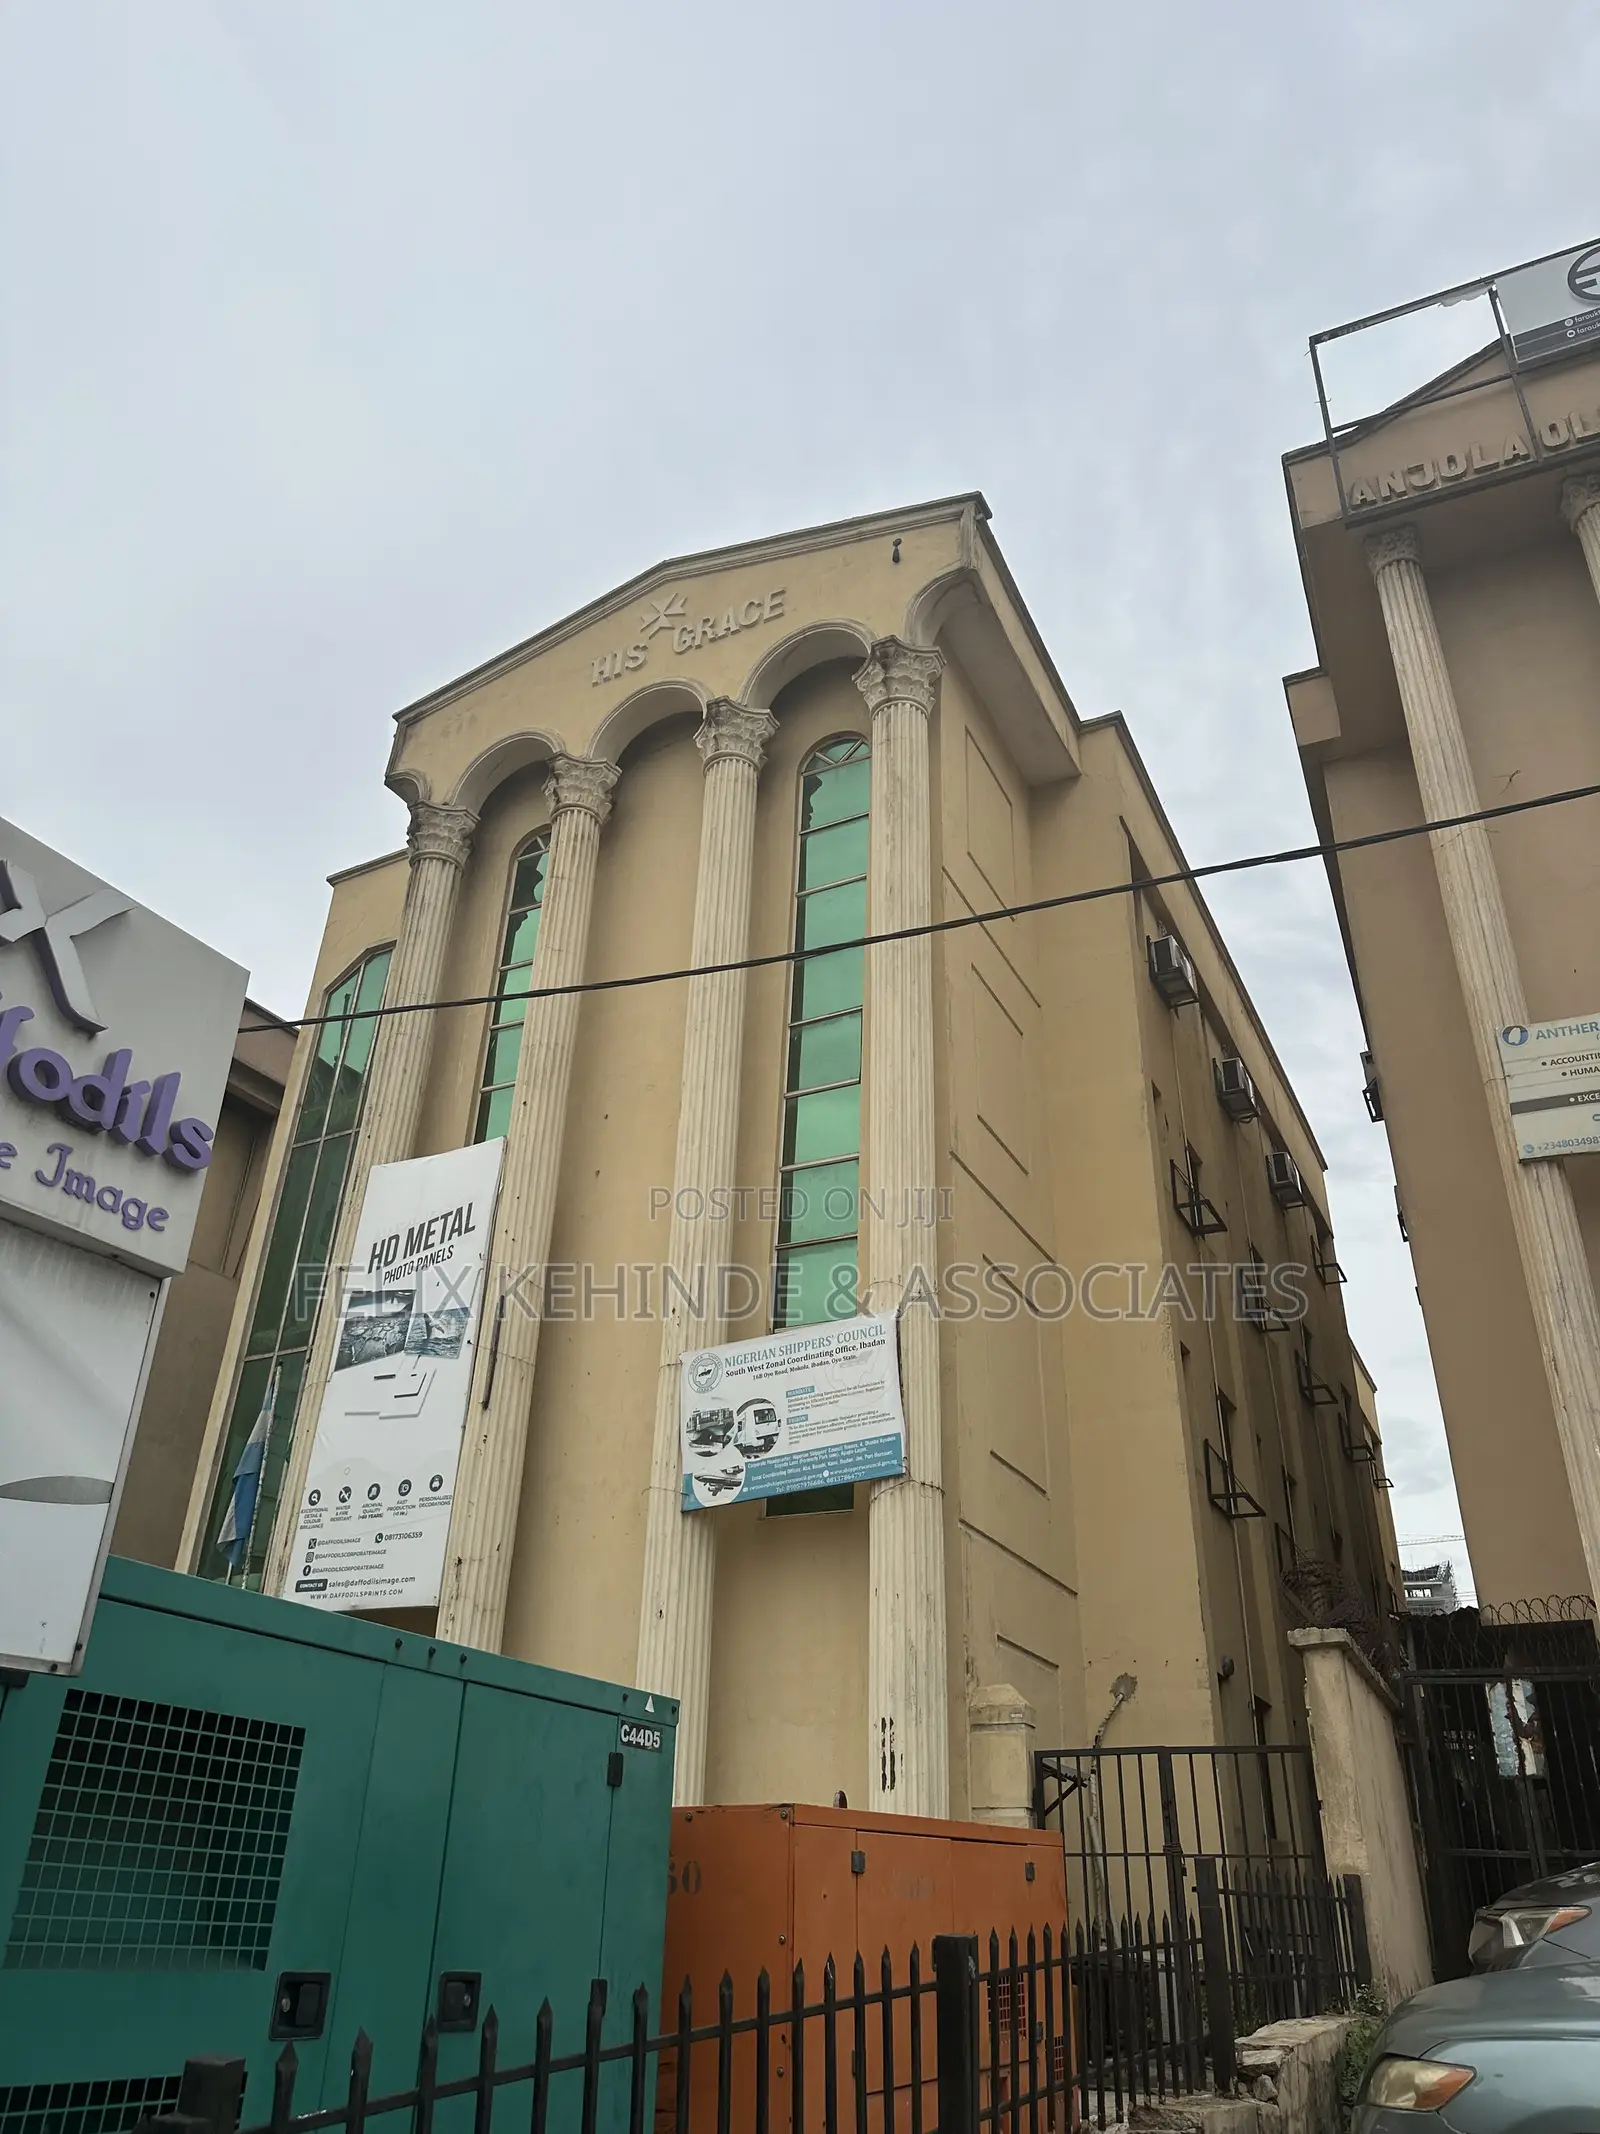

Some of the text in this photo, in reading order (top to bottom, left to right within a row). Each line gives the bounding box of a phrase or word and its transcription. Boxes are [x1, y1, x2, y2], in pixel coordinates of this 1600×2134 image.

[1351, 431, 1530, 507] ANJOLA
[591, 587, 787, 687] HIS GRACE
[367, 1201, 476, 1275] HD METAL
[383, 1244, 455, 1286] PHOTO PANELS
[724, 1347, 776, 1368] NIGERIAN
[837, 1325, 885, 1343] COUNCIL
[725, 1338, 886, 1377] South West Zonal Coordinating Office, Ibadan
[620, 1724, 661, 1749] C44D5
